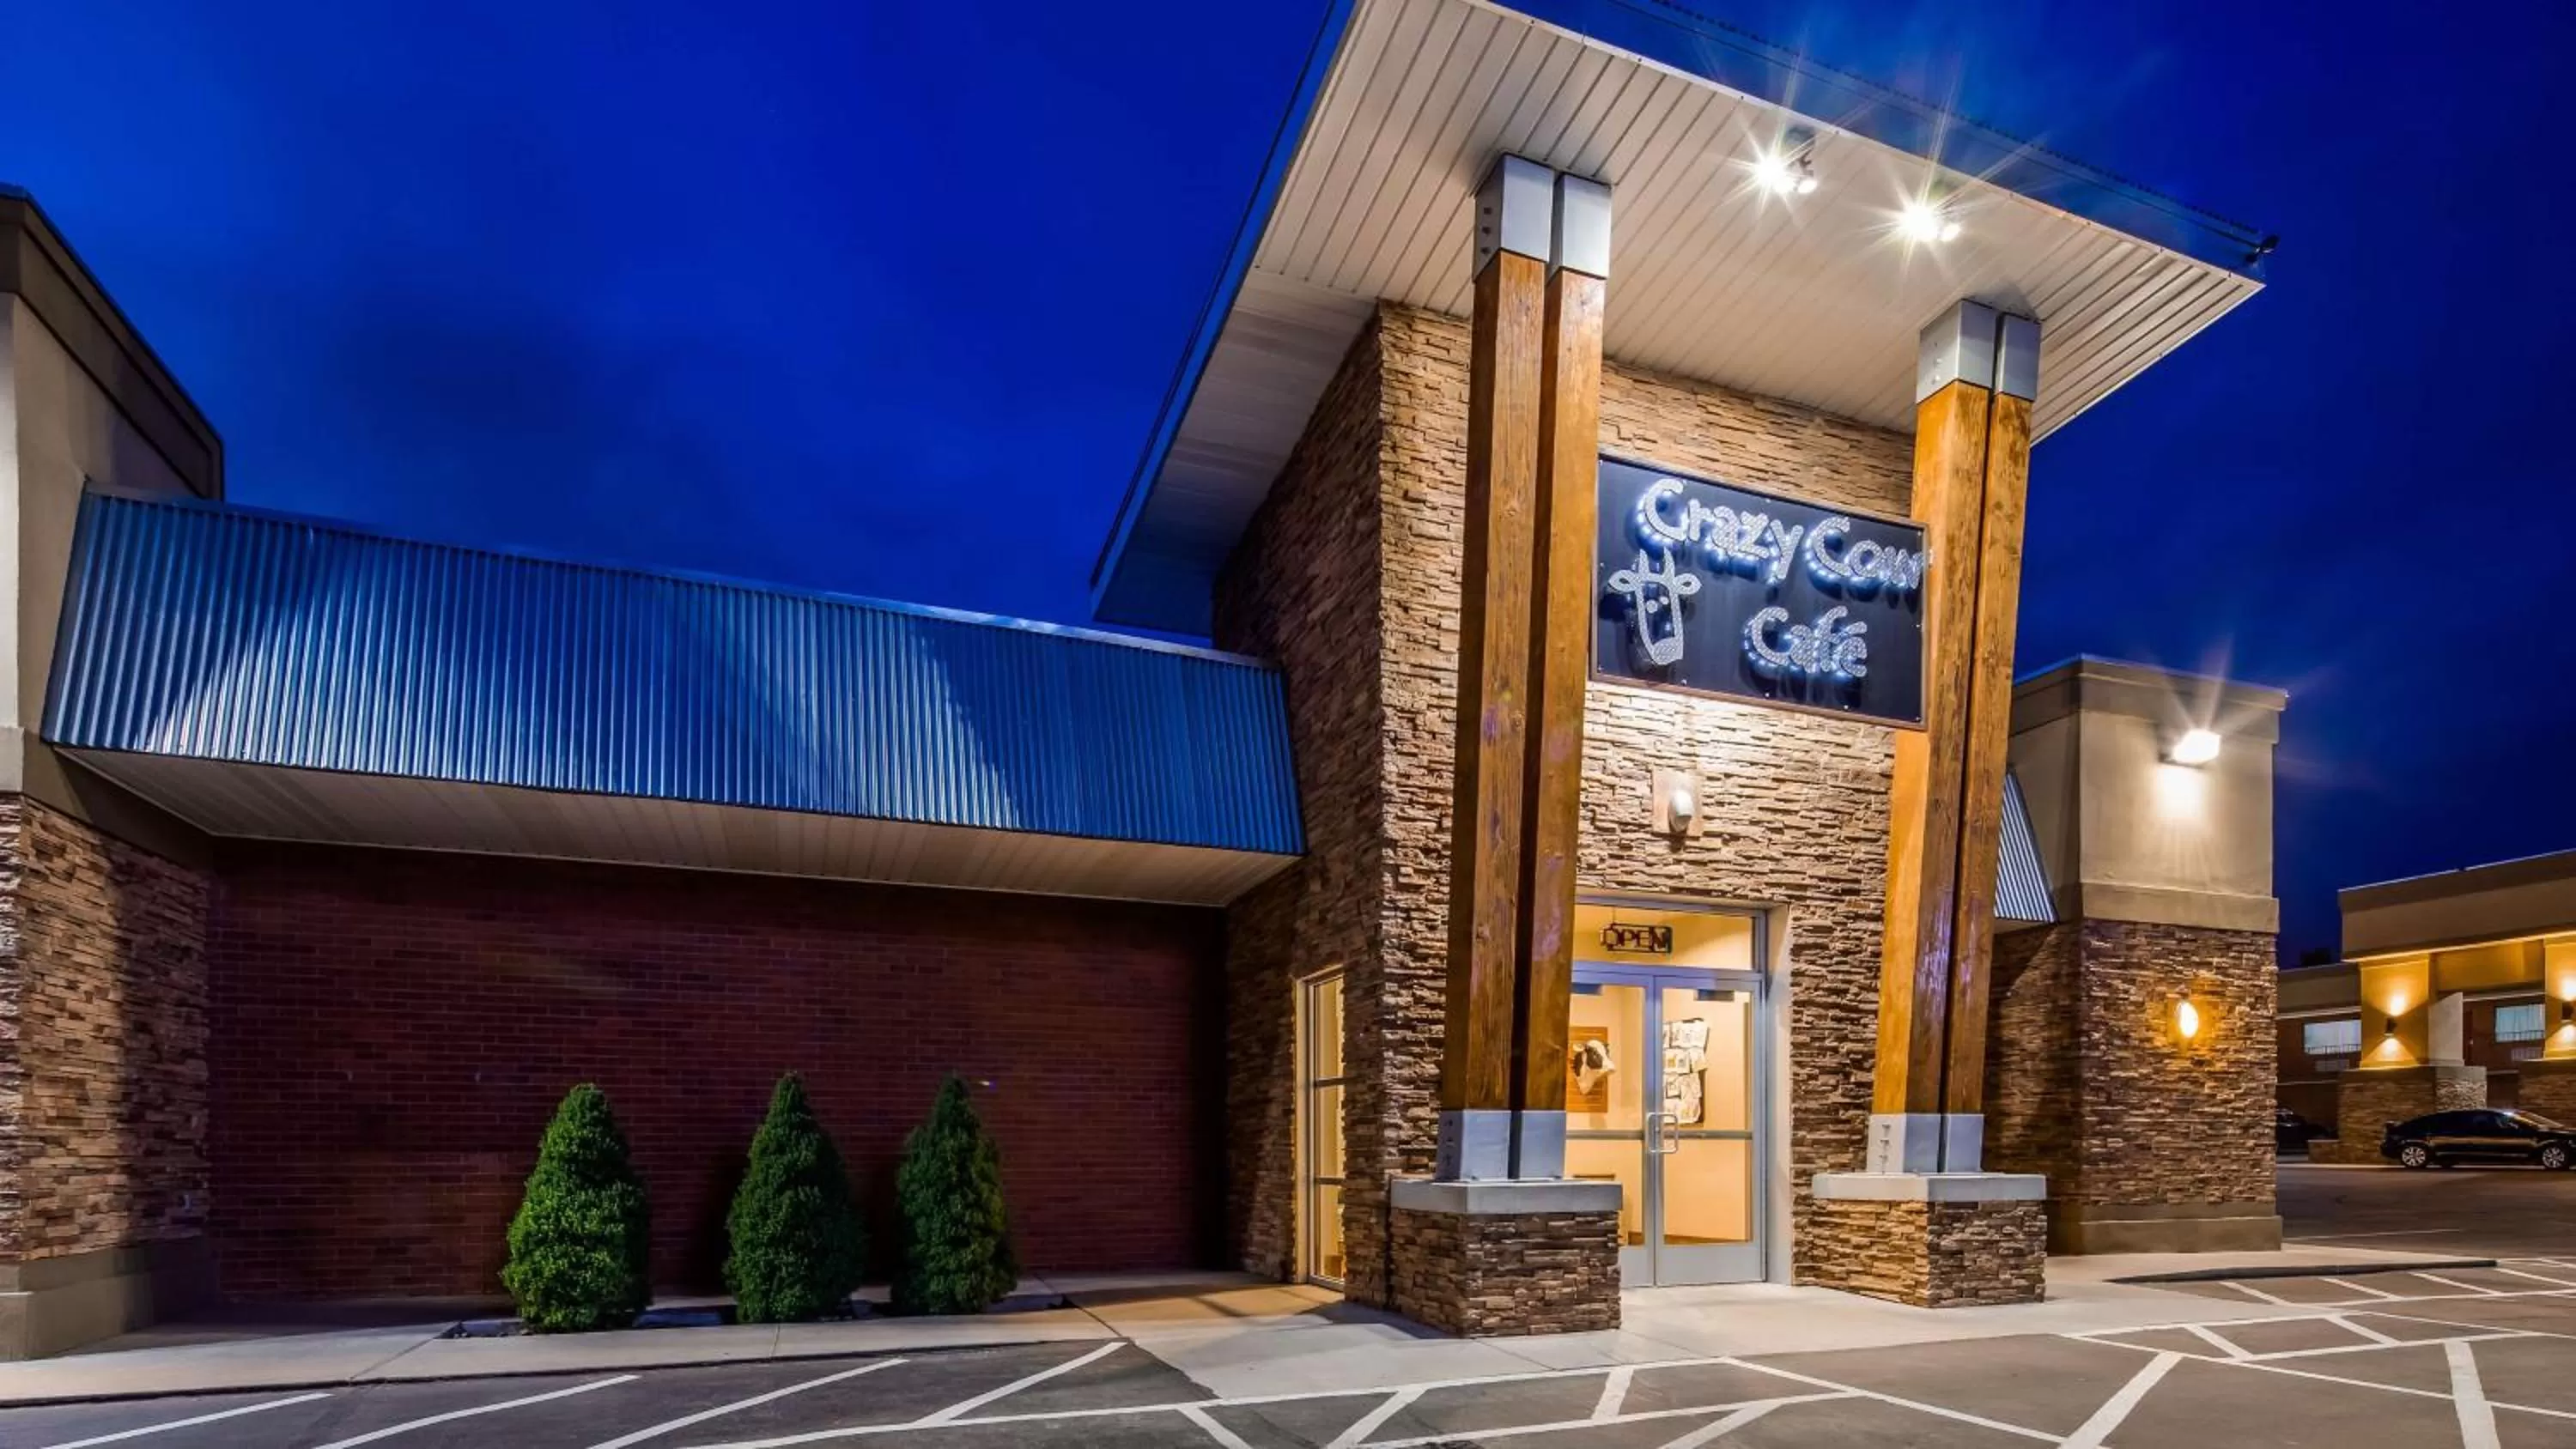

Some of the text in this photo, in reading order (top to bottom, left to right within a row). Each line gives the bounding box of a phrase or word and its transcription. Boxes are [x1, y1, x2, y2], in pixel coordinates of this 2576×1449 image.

[1642, 478, 1924, 590] Crazy Cow
[1747, 606, 1868, 677] Café
[1602, 925, 1670, 952] OPEN
